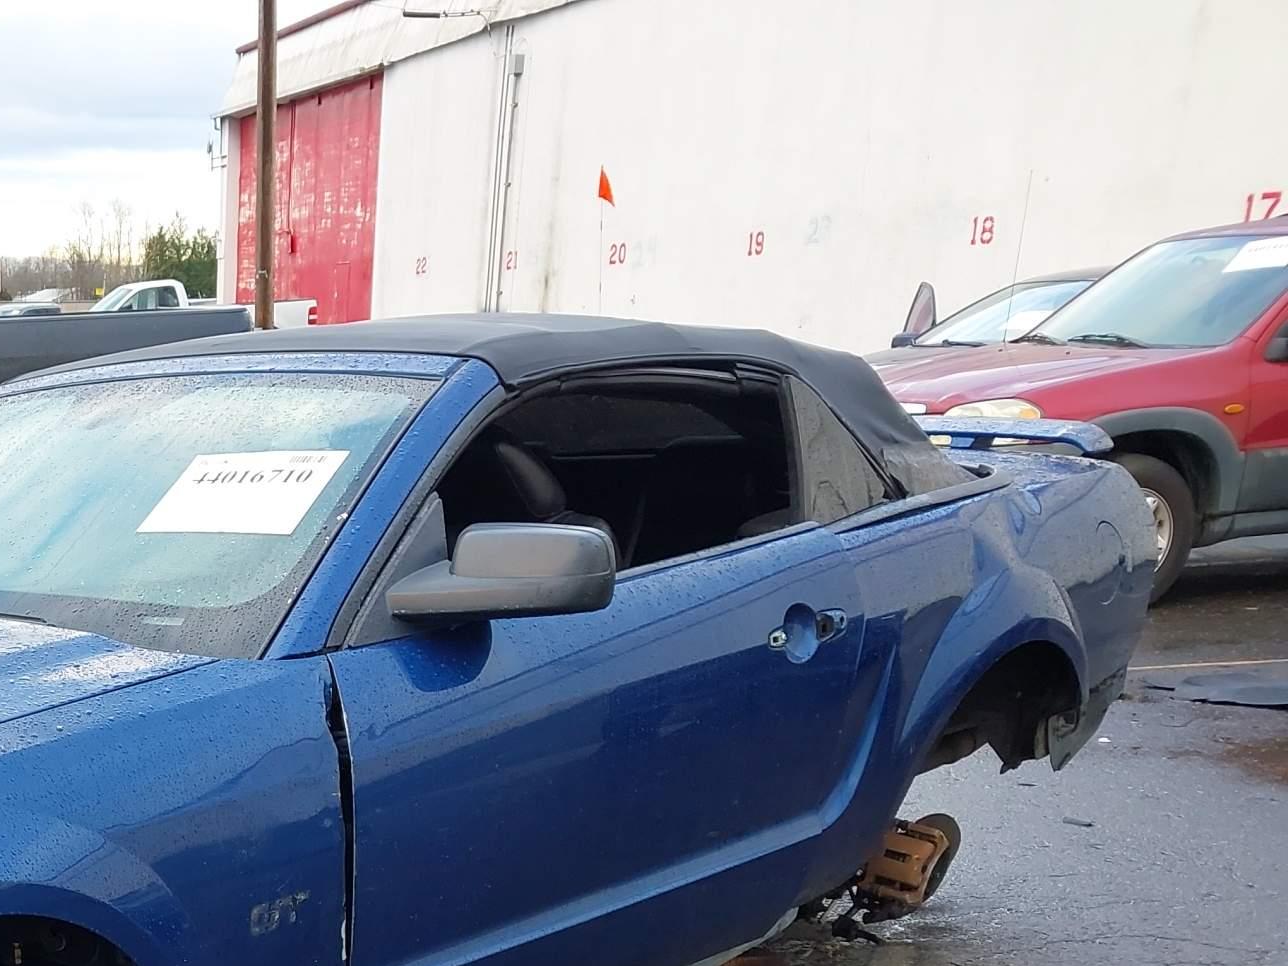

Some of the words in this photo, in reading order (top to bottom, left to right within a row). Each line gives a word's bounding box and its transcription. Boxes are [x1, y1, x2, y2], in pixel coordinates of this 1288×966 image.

[1244, 191, 1282, 223] 17
[970, 216, 995, 245] 18
[609, 242, 627, 265] 20
[747, 231, 765, 256] 19
[415, 256, 428, 275] 22
[506, 251, 518, 270] 21
[193, 469, 313, 483] 44016710
[250, 889, 310, 936] GT
